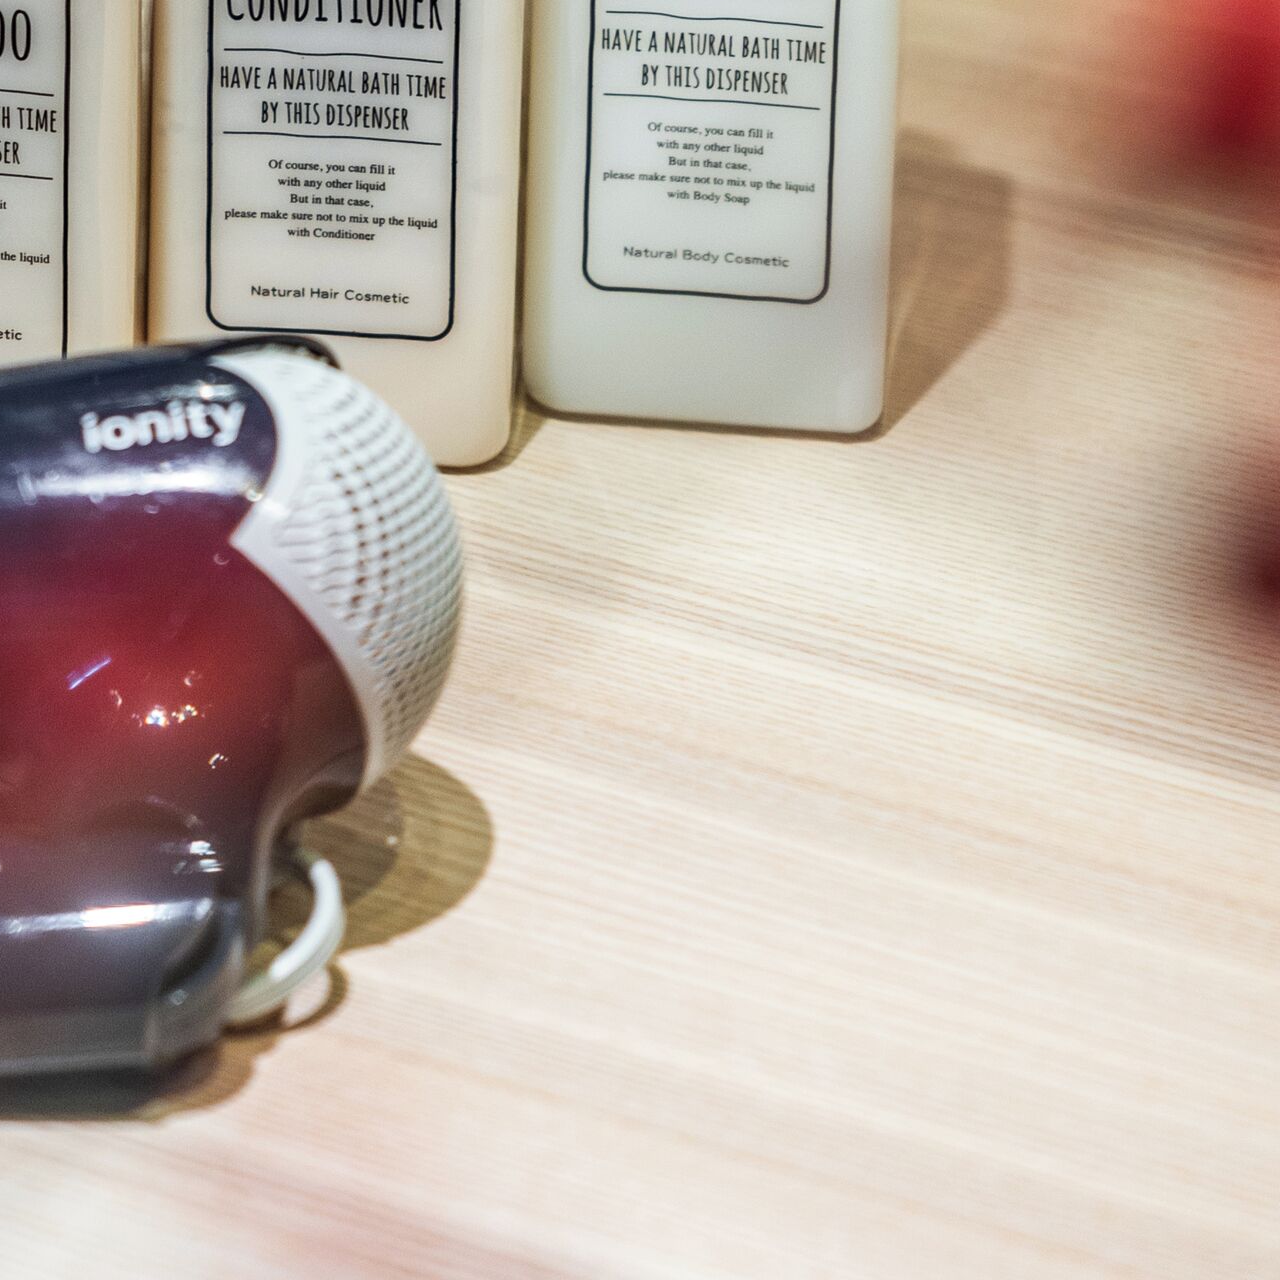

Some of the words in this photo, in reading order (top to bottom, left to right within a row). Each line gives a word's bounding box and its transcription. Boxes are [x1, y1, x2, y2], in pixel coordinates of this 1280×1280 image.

[601, 28, 642, 52] HAVE
[648, 30, 658, 53] A
[664, 31, 736, 58] NATURAL
[742, 36, 780, 60] BATH
[786, 39, 826, 64] TIME
[220, 65, 261, 90] HAVE
[267, 67, 277, 90] A
[283, 68, 356, 94] NATURAL
[361, 71, 400, 96] BATH
[406, 74, 446, 99] TIME
[641, 64, 659, 86] BY
[665, 65, 700, 89] THIS
[706, 67, 788, 95] DISPENSER
[16, 107, 57, 133] TIME
[261, 100, 279, 124] BY
[284, 101, 320, 126] THIS
[326, 103, 409, 131] DISPENSER
[647, 121, 663, 132] Of
[664, 125, 703, 135] course,
[704, 127, 724, 137] you
[726, 129, 745, 137] can
[747, 128, 763, 139] fill
[766, 129, 774, 140] it
[656, 139, 680, 150] with
[682, 143, 701, 153] any
[703, 142, 732, 153] other
[733, 144, 764, 157] liquid
[268, 159, 284, 169] Of
[285, 162, 323, 172] course,
[325, 164, 346, 174] you
[348, 165, 367, 174] can
[369, 164, 385, 175] fill
[387, 165, 396, 175] it
[668, 156, 687, 167] But
[689, 157, 700, 167] in
[702, 158, 723, 169] that
[725, 162, 751, 172] case,
[277, 176, 301, 187] with
[303, 179, 323, 190] any
[325, 178, 353, 189] other
[355, 180, 386, 193] liquid
[602, 170, 635, 181] please
[638, 172, 667, 182] make
[669, 175, 691, 183] sure
[693, 176, 711, 185] not
[713, 177, 724, 186] to
[726, 177, 747, 187] mix
[749, 181, 764, 191] up
[765, 179, 782, 190] the
[784, 181, 816, 194] liquid
[0, 199, 7, 210] it
[289, 193, 309, 204] But
[311, 194, 322, 205] in
[324, 195, 345, 206] that
[347, 198, 374, 208] case,
[667, 189, 690, 200] with
[693, 190, 721, 204] Body
[724, 192, 751, 206] Soap
[224, 208, 257, 220] please
[260, 210, 289, 220] make
[291, 212, 313, 221] sure
[316, 213, 333, 222] not
[335, 213, 347, 223] to
[349, 213, 370, 224] mix
[372, 217, 386, 227] up
[388, 216, 405, 226] the
[407, 217, 438, 230] liquid
[287, 227, 310, 237] with
[312, 227, 376, 241] Conditioner
[0, 251, 17, 261] the
[19, 252, 50, 266] liquid
[623, 246, 678, 260] Natural
[682, 249, 720, 264] Body
[724, 252, 790, 268] Cosmetic
[251, 285, 305, 298] Natural
[310, 288, 340, 299] Hair
[344, 289, 410, 304] Cosmetic
[80, 400, 246, 454] ionity
